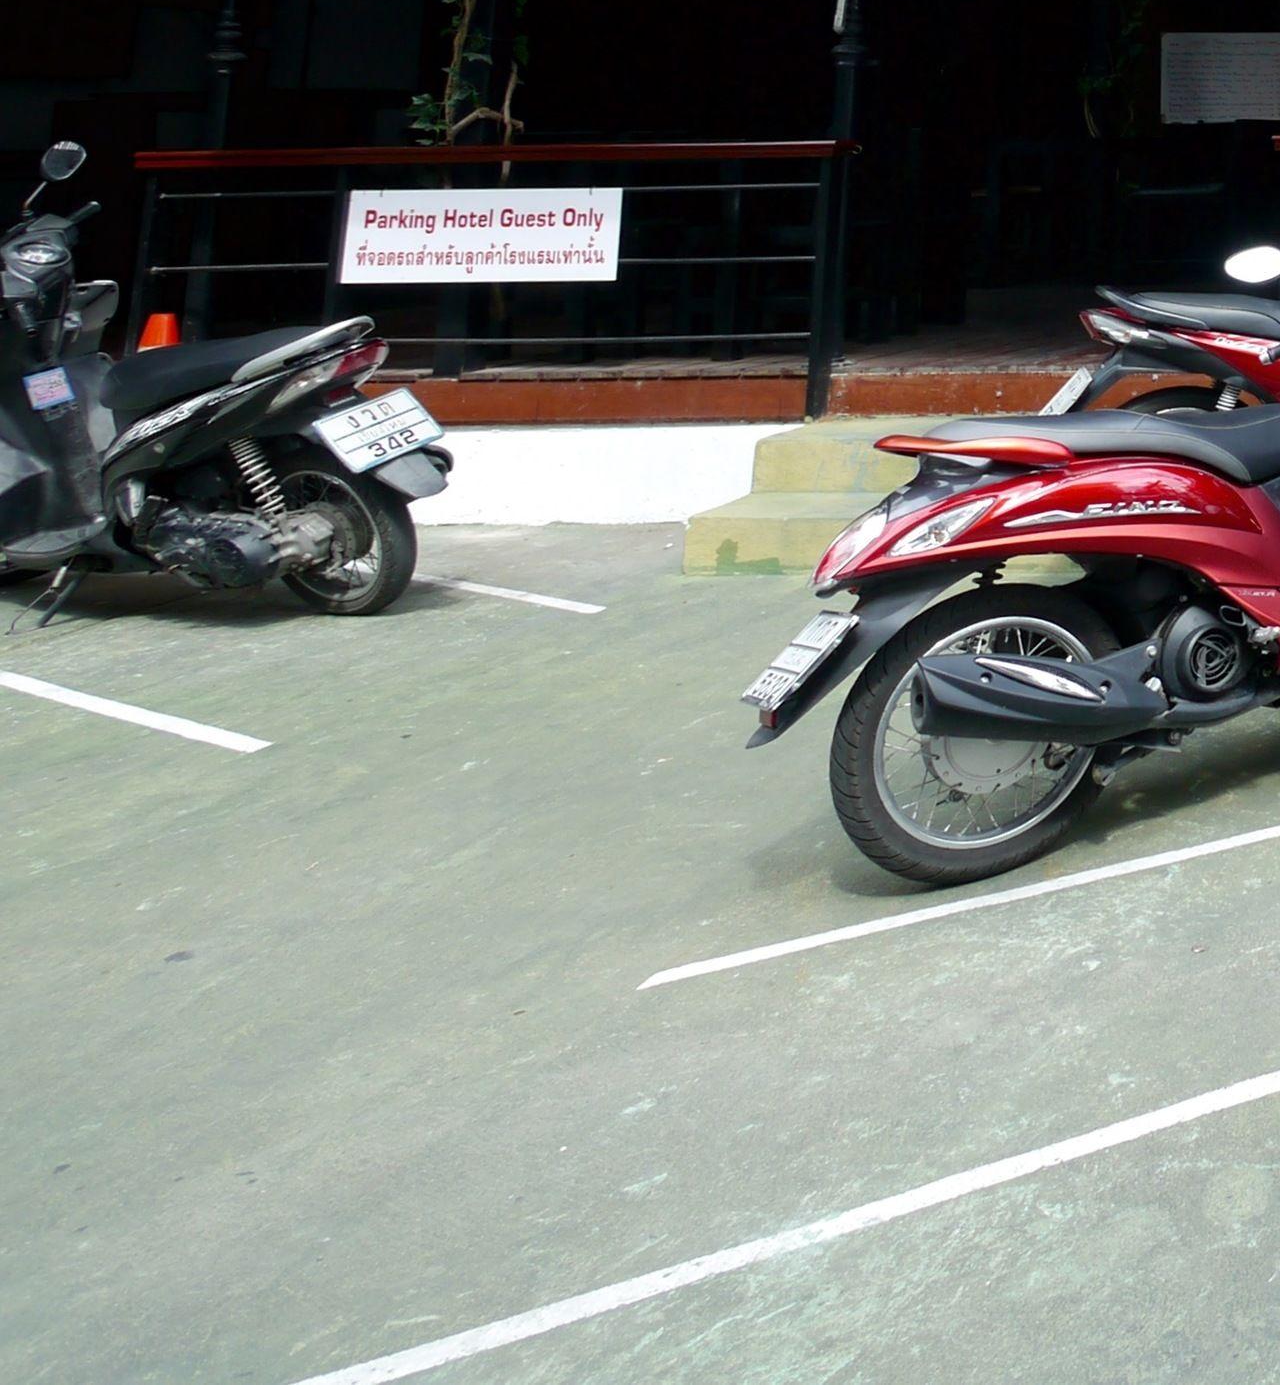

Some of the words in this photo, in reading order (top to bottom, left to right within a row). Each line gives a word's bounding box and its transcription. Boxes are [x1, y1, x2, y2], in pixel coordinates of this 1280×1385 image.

[364, 209, 437, 234] Parking
[443, 209, 494, 229] Hotel
[500, 208, 556, 228] Guest
[563, 207, 605, 232] Only
[368, 429, 419, 458] 342
